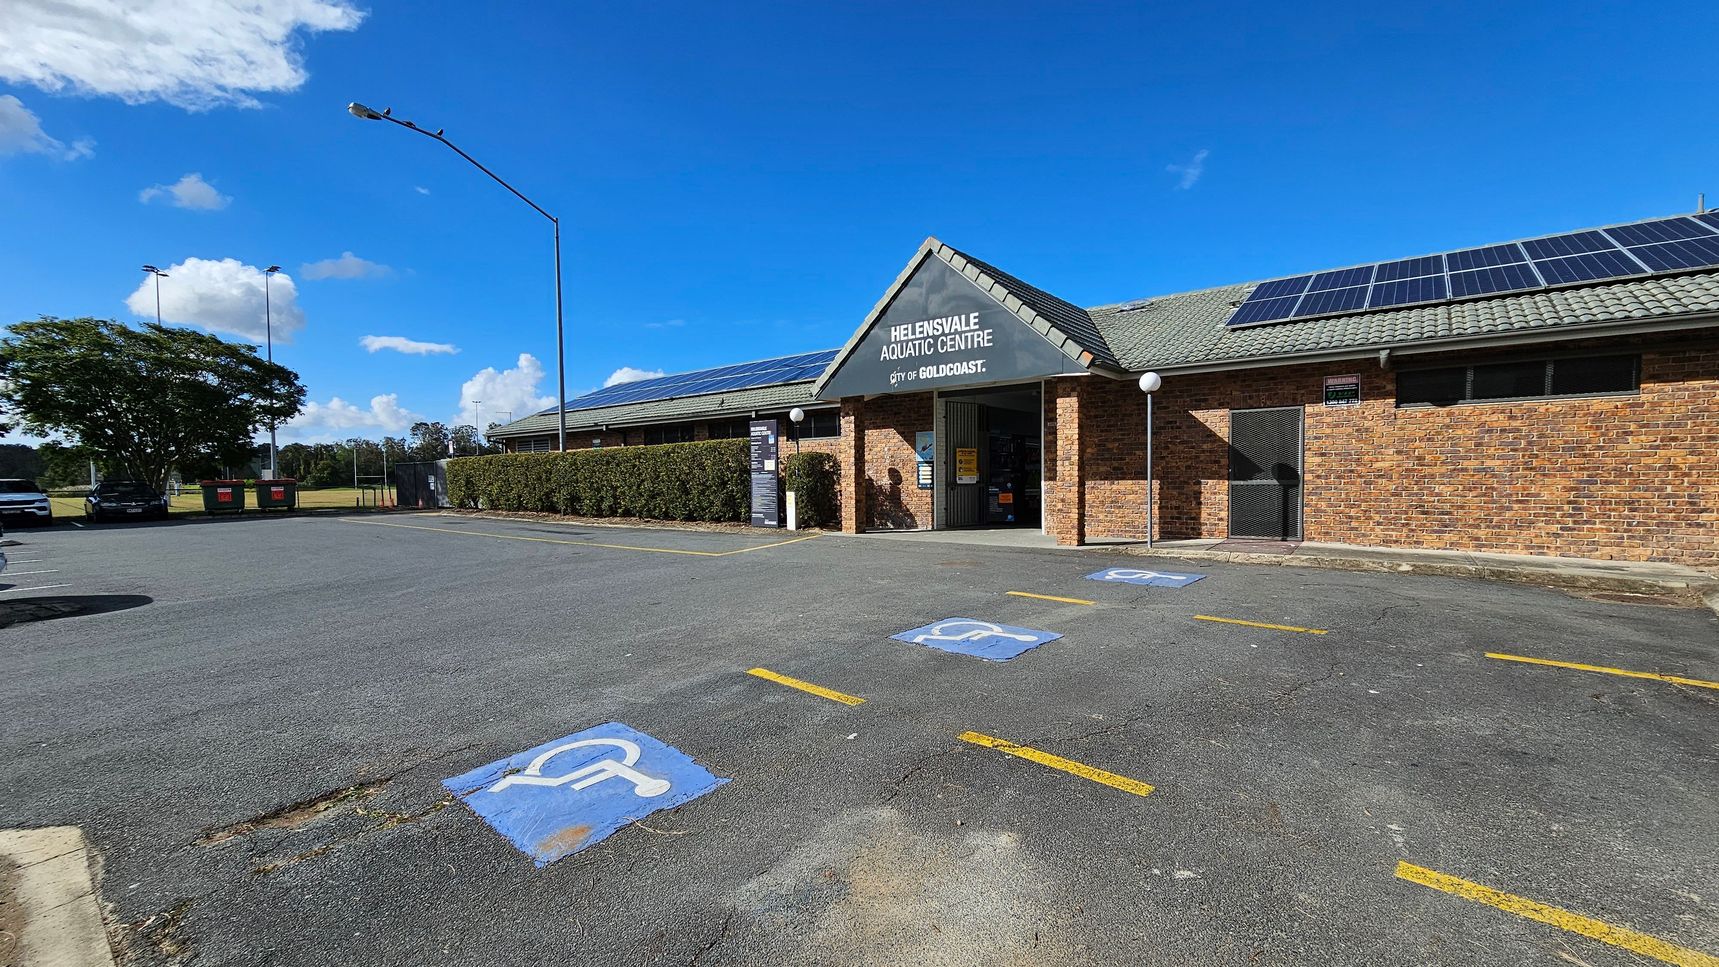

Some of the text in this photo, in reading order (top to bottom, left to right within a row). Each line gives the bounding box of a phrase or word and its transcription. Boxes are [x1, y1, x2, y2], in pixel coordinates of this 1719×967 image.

[891, 312, 980, 342] HELENSVALE
[880, 329, 993, 361] AQUATIC CENTRE
[890, 371, 906, 385] CITY
[907, 371, 918, 381] OF
